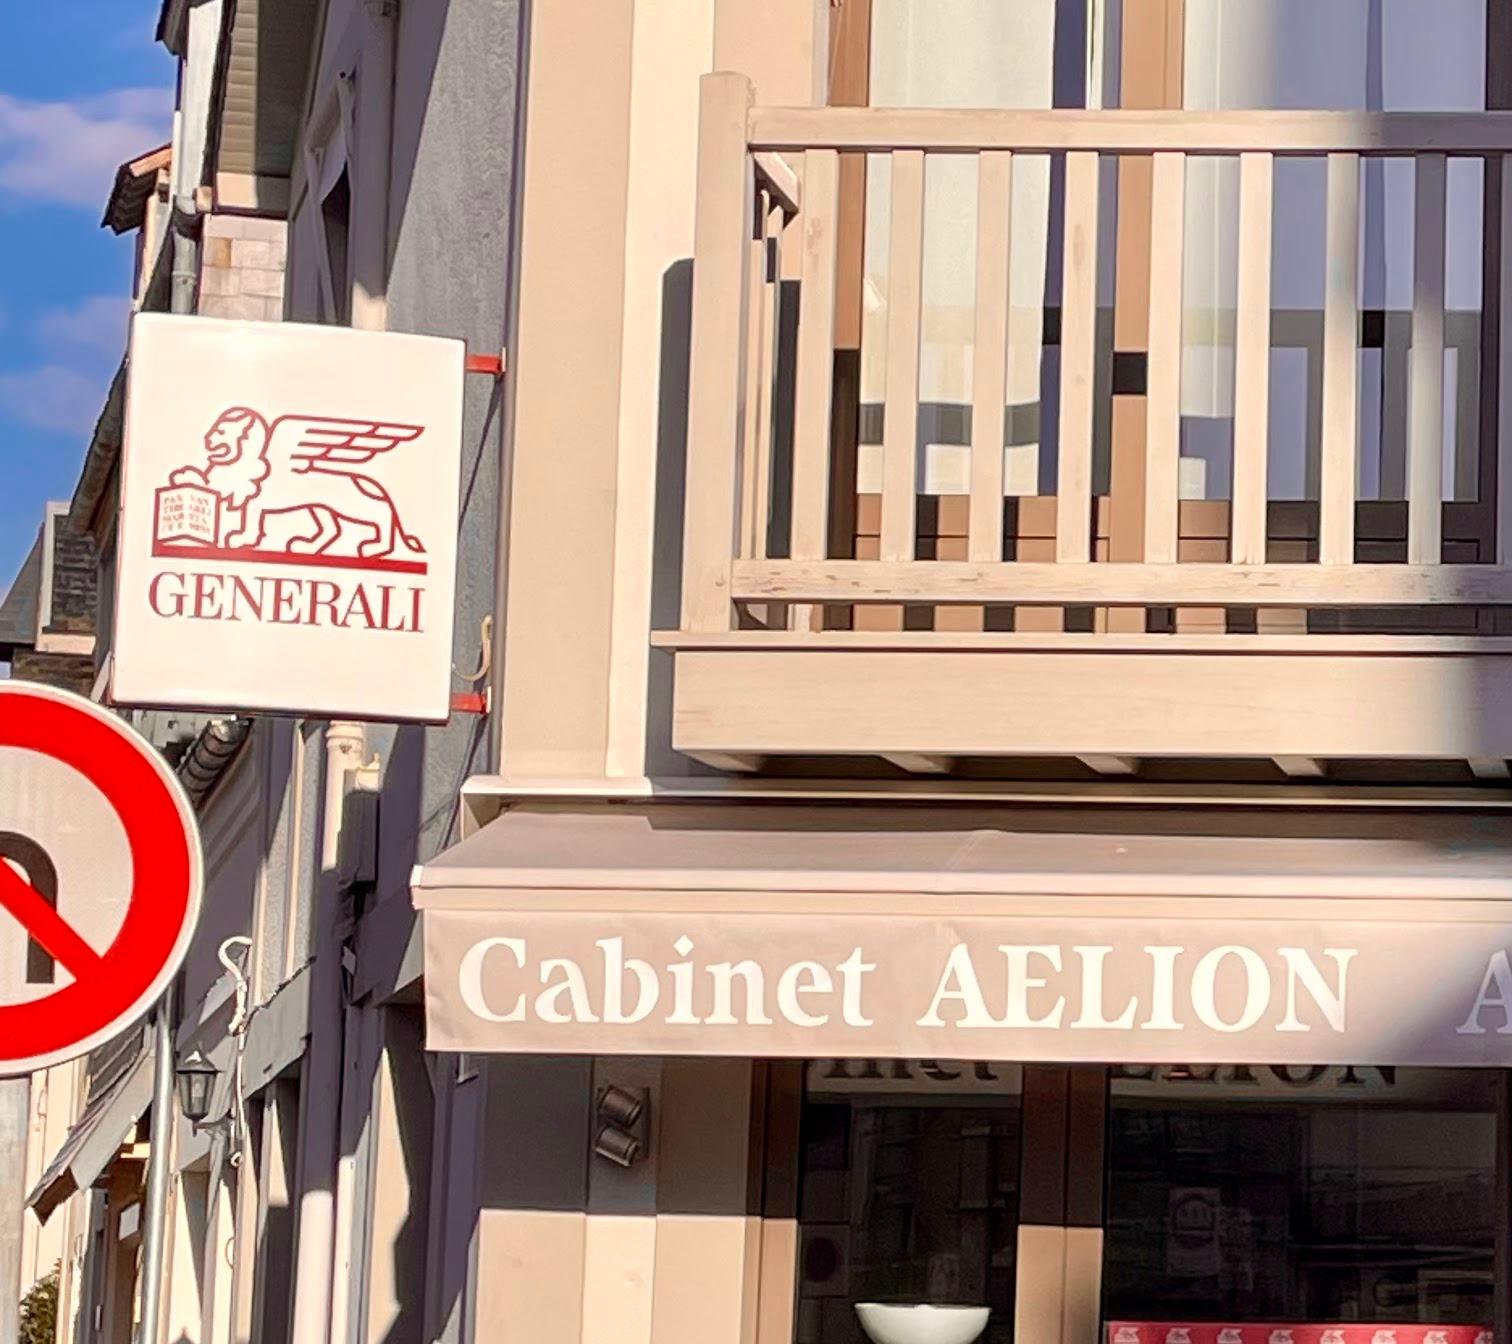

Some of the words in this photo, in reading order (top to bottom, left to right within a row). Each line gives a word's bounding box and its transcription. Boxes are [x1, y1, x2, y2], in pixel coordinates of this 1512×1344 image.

[149, 571, 427, 634] GENERALI
[457, 937, 874, 1031] Cabinet
[916, 945, 1356, 1034] AELION
